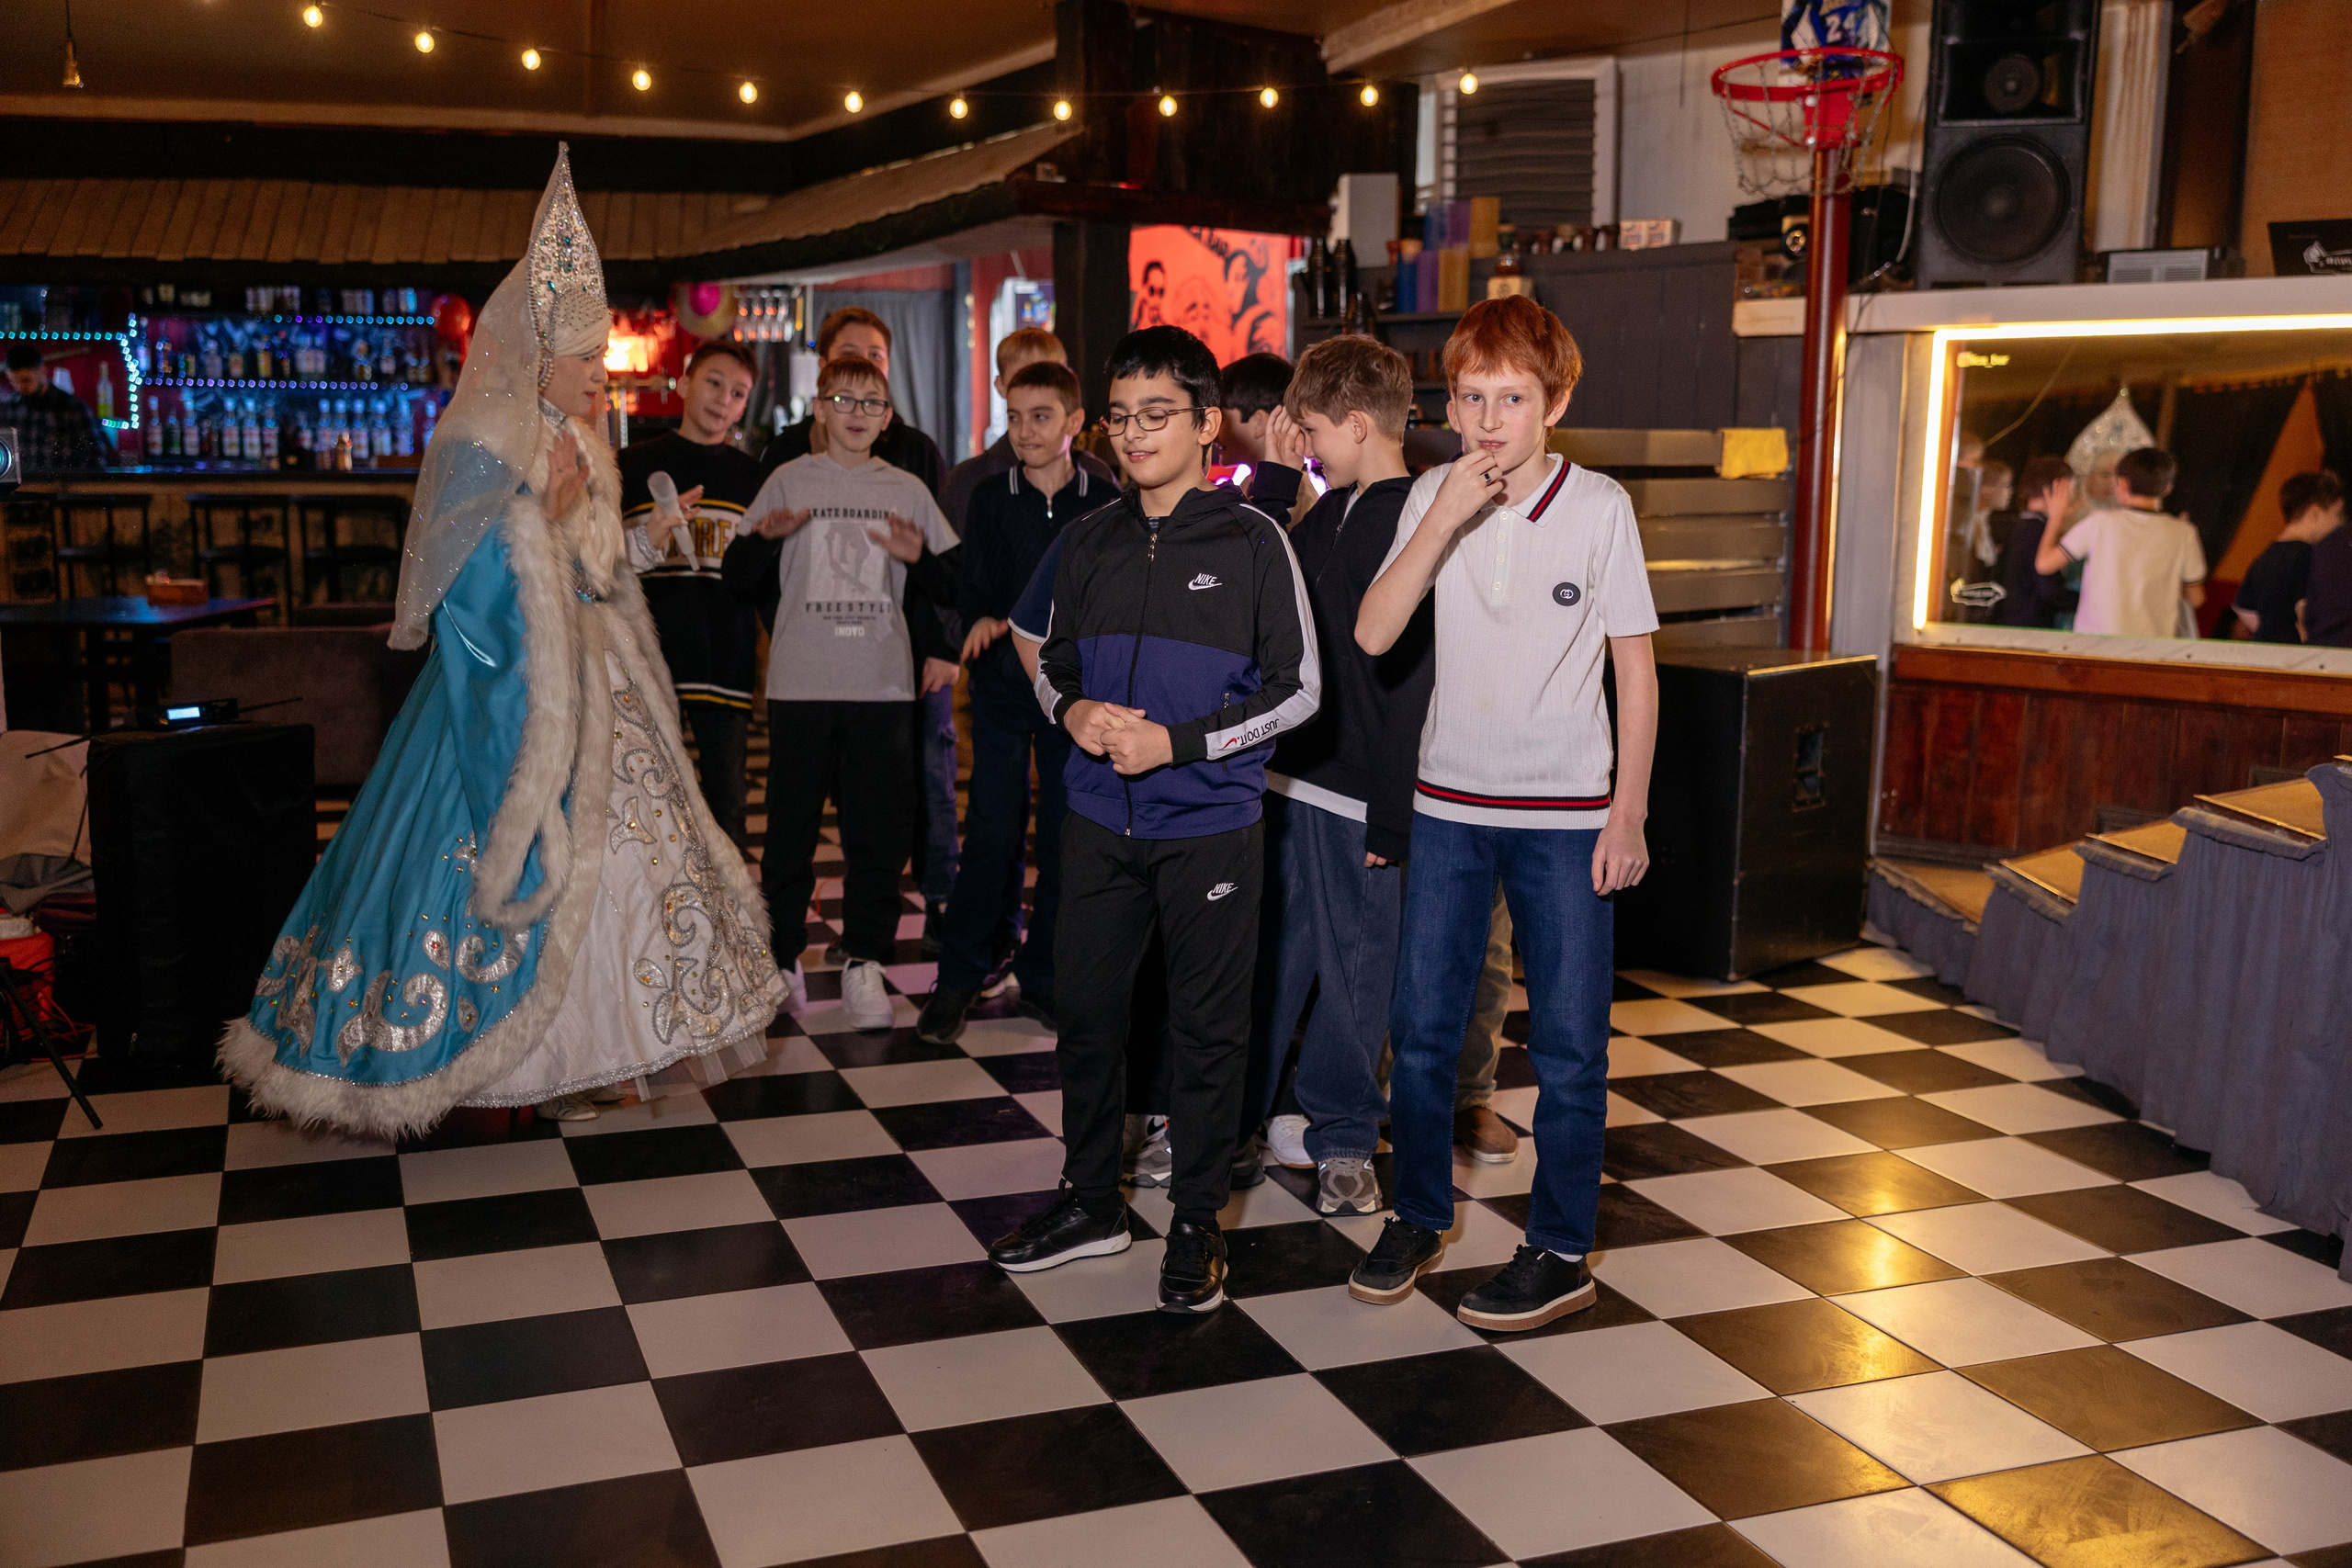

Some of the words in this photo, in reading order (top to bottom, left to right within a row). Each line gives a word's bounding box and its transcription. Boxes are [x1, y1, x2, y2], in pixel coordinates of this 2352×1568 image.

[808, 508, 895, 520] KATEBOARDIN
[1194, 572, 1217, 585] NIKE
[1261, 718, 1280, 736] JUST
[1248, 728, 1260, 741] DO
[1213, 882, 1235, 894] NIKE
